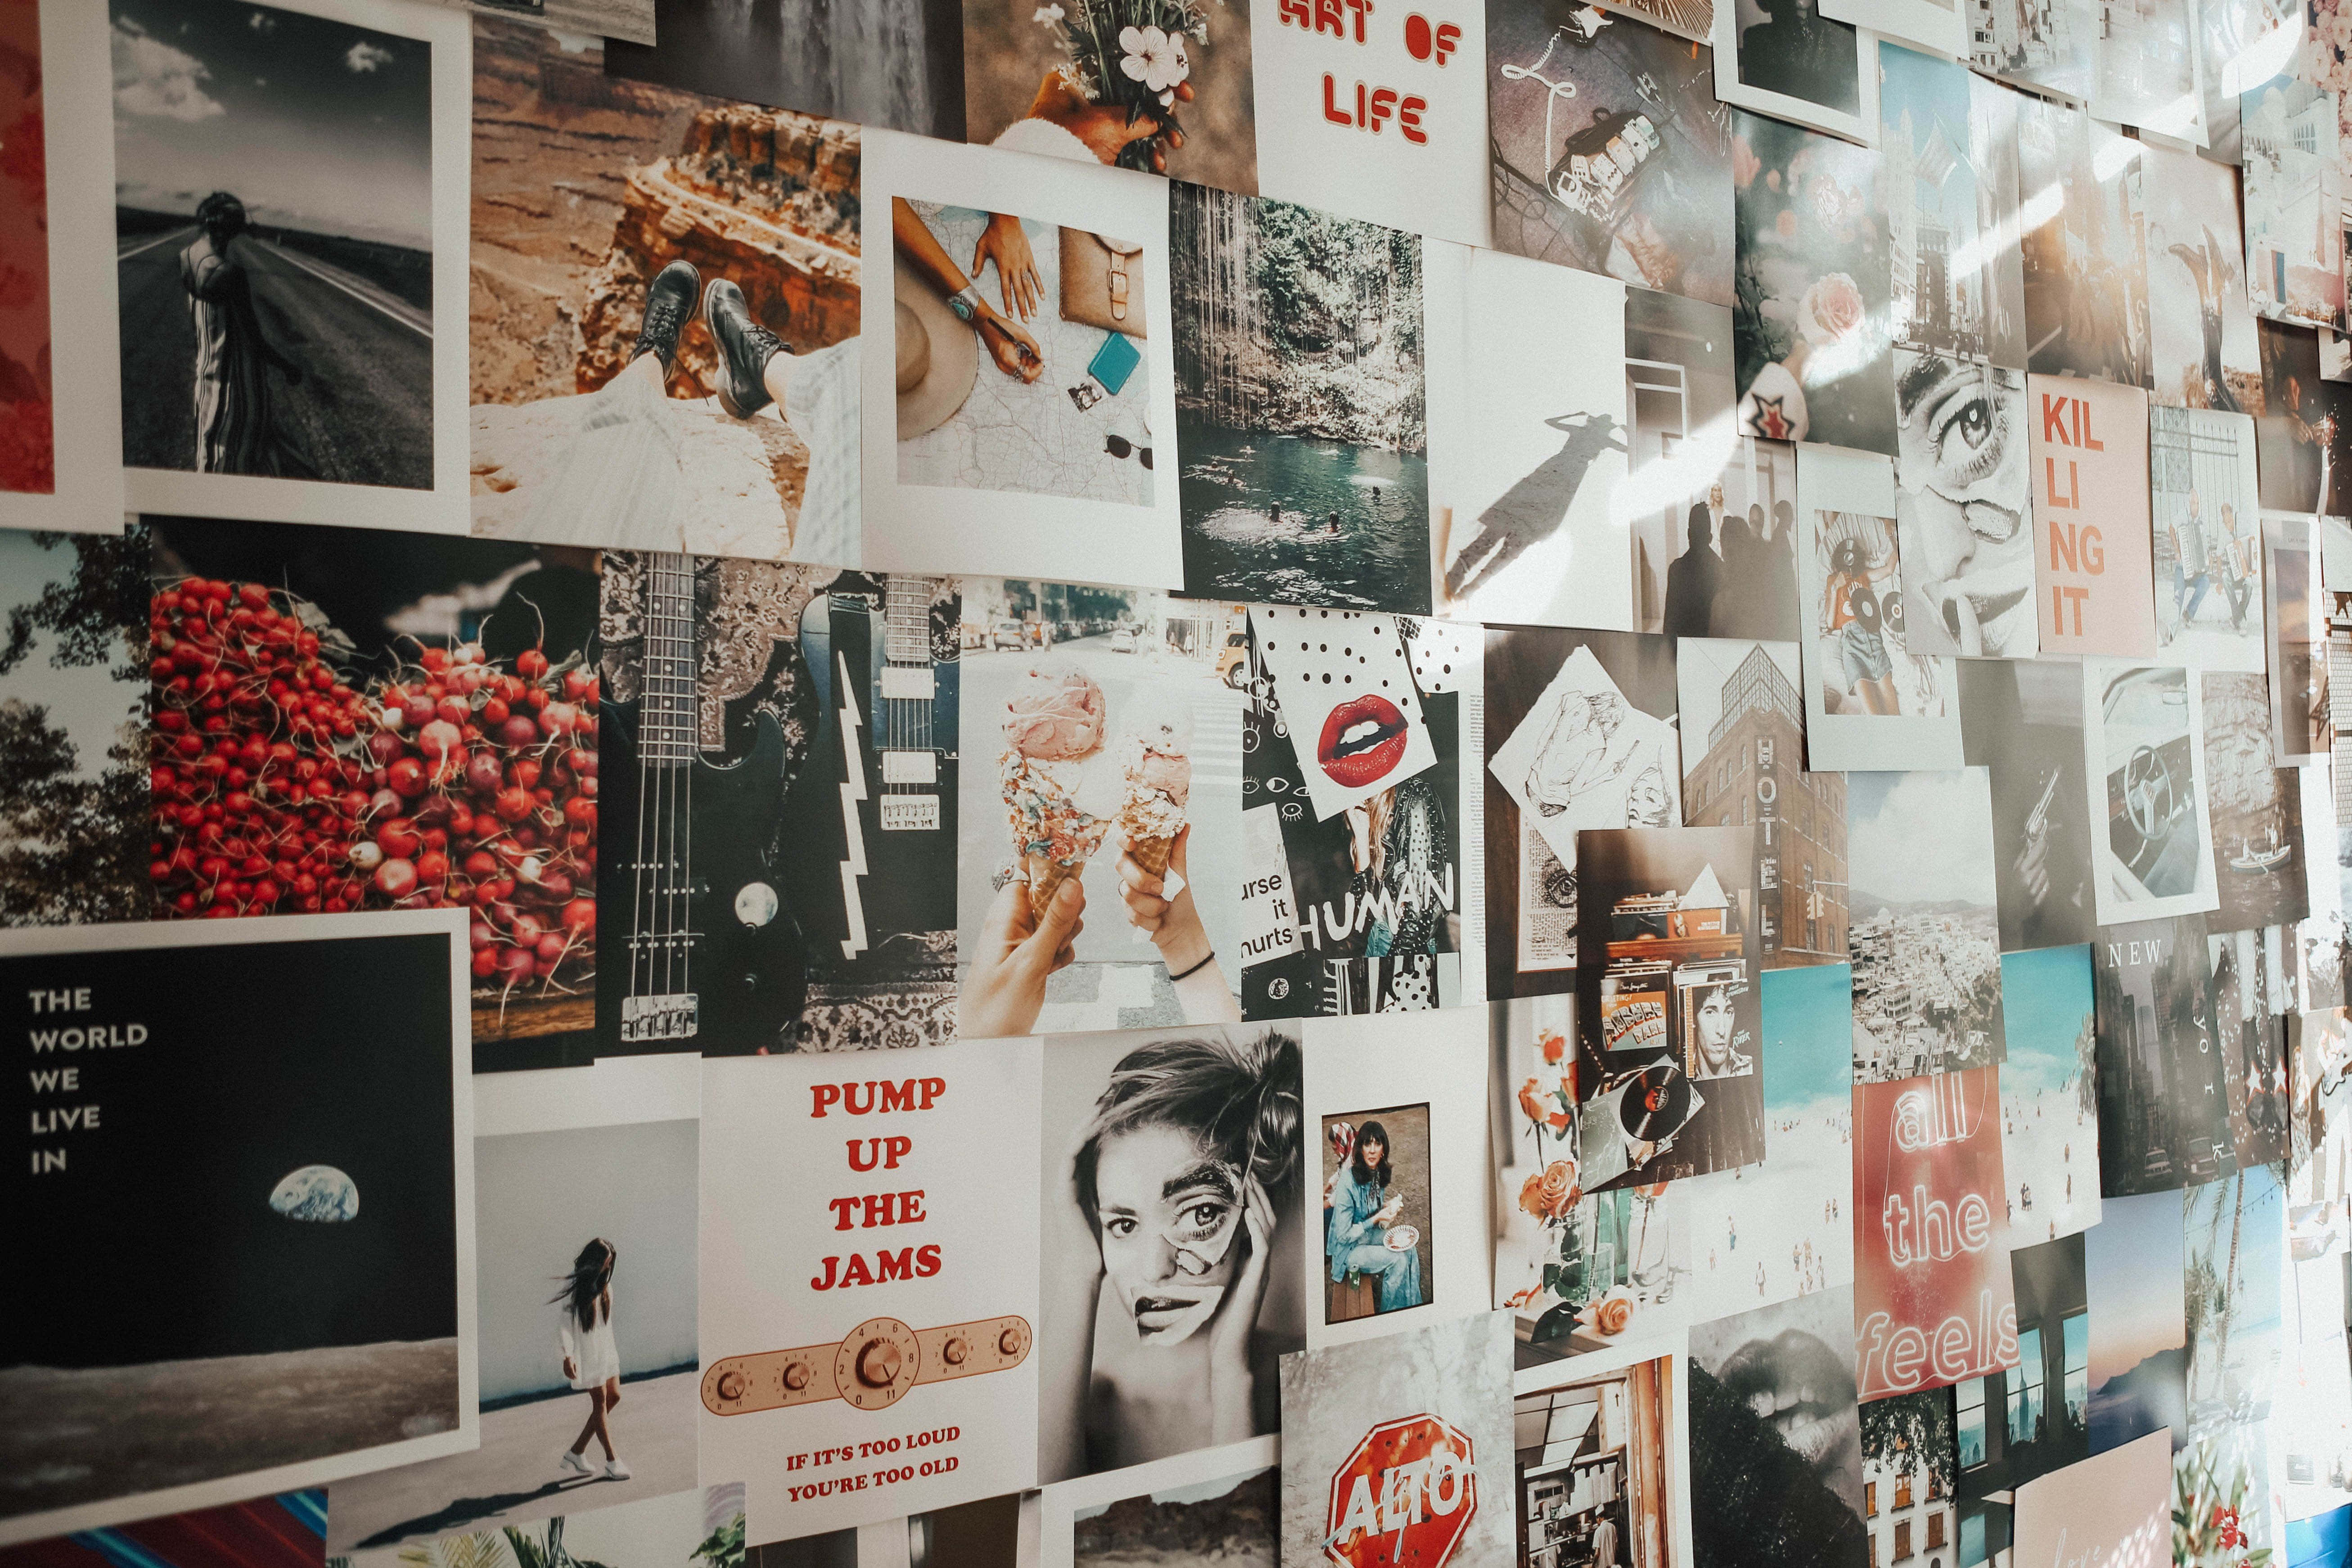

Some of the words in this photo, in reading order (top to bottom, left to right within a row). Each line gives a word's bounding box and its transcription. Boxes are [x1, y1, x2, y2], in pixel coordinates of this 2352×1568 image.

[1403, 12, 1463, 68] OF
[1321, 71, 1428, 147] LIFE
[2042, 394, 2104, 451] KIL
[2046, 457, 2079, 510] LI
[2049, 521, 2104, 576] NG
[2053, 586, 2089, 636] IT
[1757, 739, 1778, 936] HOTEL
[1272, 899, 1289, 919] it
[1300, 862, 1454, 951] HUMAN
[2109, 939, 2161, 968] NEW
[29, 988, 91, 1014] THE
[29, 1023, 149, 1054] WORLD
[30, 1068, 80, 1093] WE
[810, 1077, 946, 1118] PUMP
[32, 1105, 101, 1134] LIVE
[1895, 1071, 1968, 1153] all
[32, 1148, 67, 1175] IN
[846, 1136, 912, 1172] UP
[829, 1190, 926, 1231] THE
[1883, 1185, 1990, 1267] the
[811, 1245, 942, 1291] JAMS
[859, 1328, 864, 1337] 4
[893, 1324, 898, 1333] 6
[1855, 1289, 2020, 1398] feels
[839, 1364, 844, 1374] 2
[909, 1353, 914, 1363] 8
[856, 1395, 861, 1405] 0
[887, 1389, 895, 1400] 11
[787, 1454, 808, 1471] IF
[813, 1446, 854, 1466] IT'S
[859, 1438, 901, 1458] TOO
[906, 1427, 960, 1449] LOUD
[788, 1474, 868, 1502] YOU'RE
[873, 1466, 914, 1486] TOO
[919, 1456, 959, 1477] OLD
[1338, 1452, 1464, 1545] ALTO
